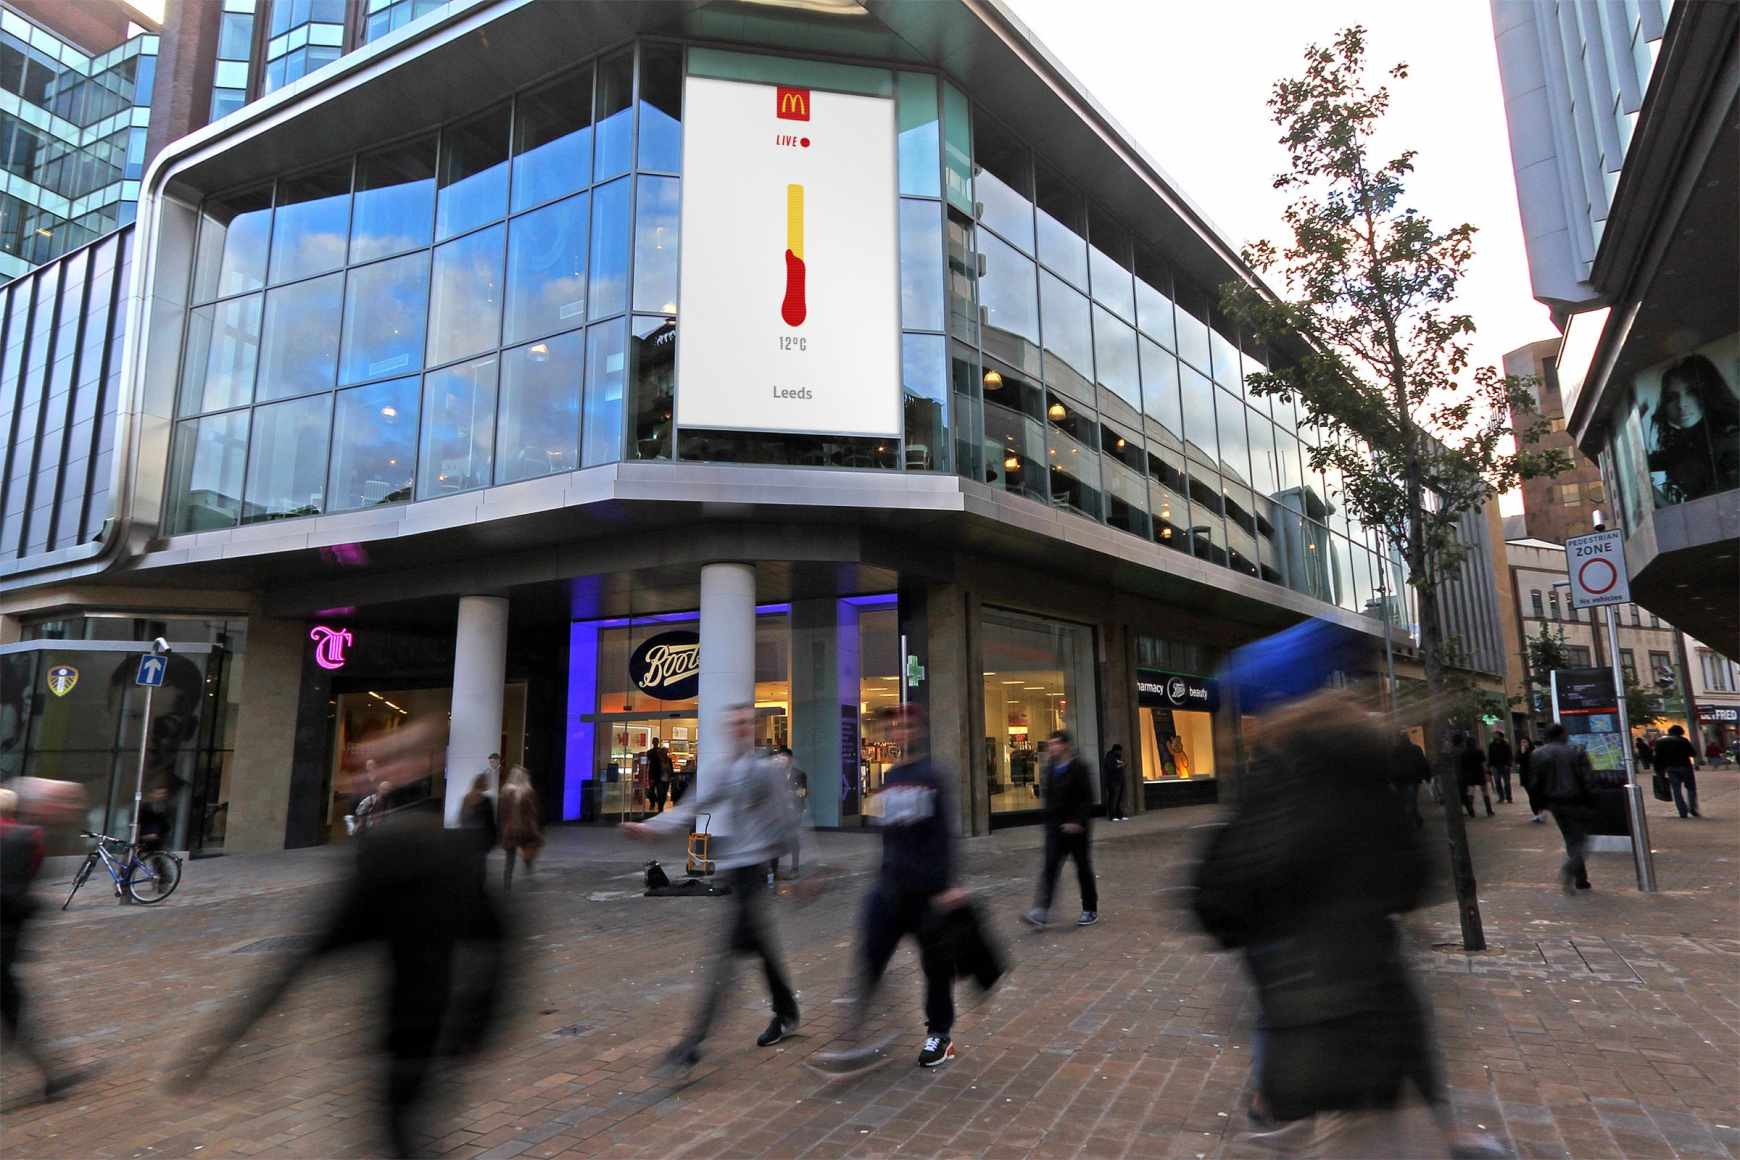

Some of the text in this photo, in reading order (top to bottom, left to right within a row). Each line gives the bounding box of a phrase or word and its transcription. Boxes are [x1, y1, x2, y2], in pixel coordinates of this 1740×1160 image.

[776, 134, 798, 147] LIVE
[773, 385, 813, 400] Leeds
[1568, 533, 1619, 546] PEDESTRIAN
[1576, 542, 1613, 557] ZONE
[1189, 686, 1208, 702] beauty
